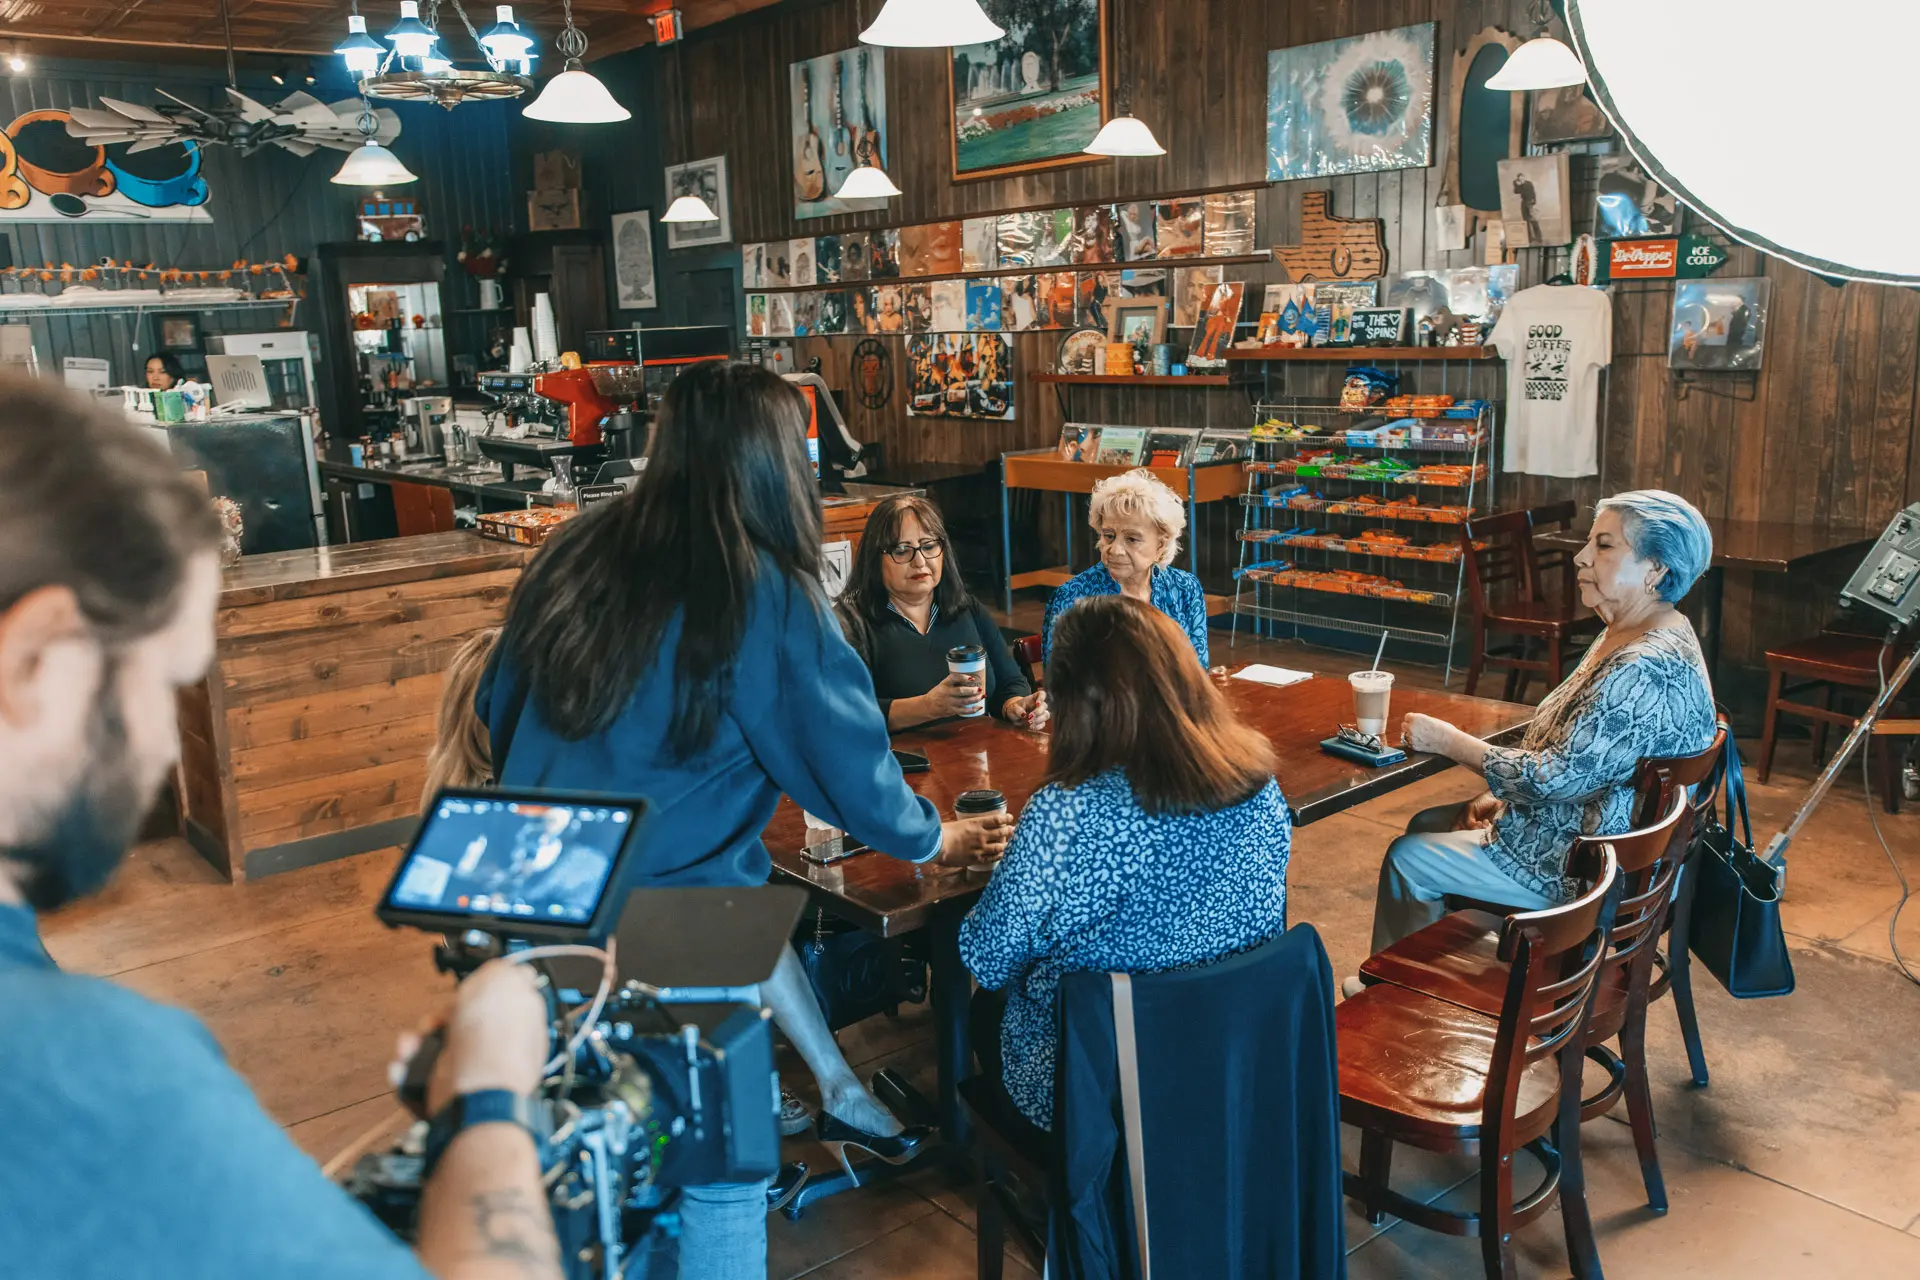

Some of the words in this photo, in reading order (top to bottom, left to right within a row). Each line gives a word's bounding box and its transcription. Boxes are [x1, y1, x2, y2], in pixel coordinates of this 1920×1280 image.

[1691, 246, 1710, 256] ICE
[1686, 255, 1718, 266] COLD
[1368, 314, 1388, 327] THE
[1366, 326, 1397, 340] SPINS
[1528, 324, 1563, 338] GOOD
[1526, 339, 1572, 352] COFFEE
